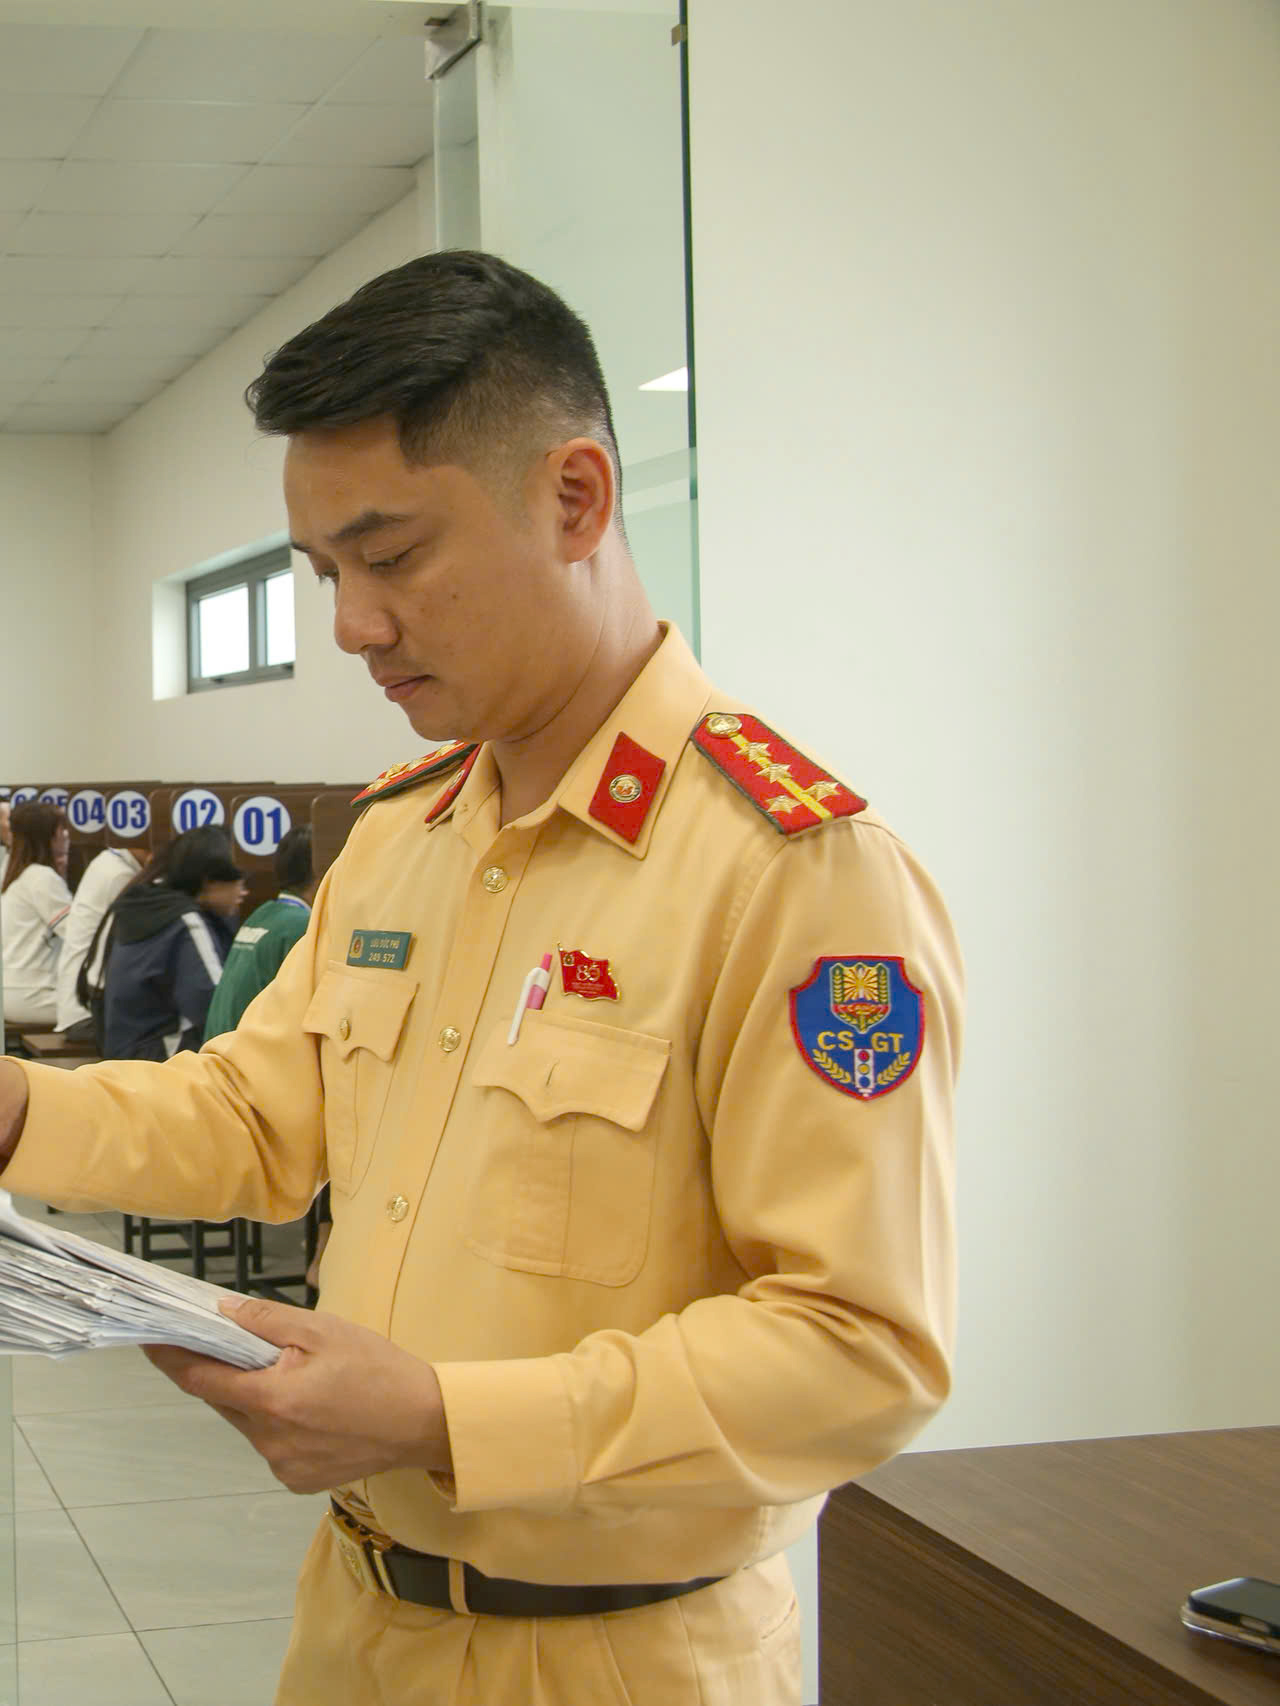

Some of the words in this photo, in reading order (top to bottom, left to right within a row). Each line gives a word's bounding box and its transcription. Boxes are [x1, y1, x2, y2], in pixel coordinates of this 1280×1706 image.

[73, 797, 105, 826] 04
[111, 798, 147, 830] 03
[180, 798, 217, 832] 02
[243, 806, 281, 845] 01
[817, 1031, 855, 1051] CS
[871, 1032, 904, 1053] GT
